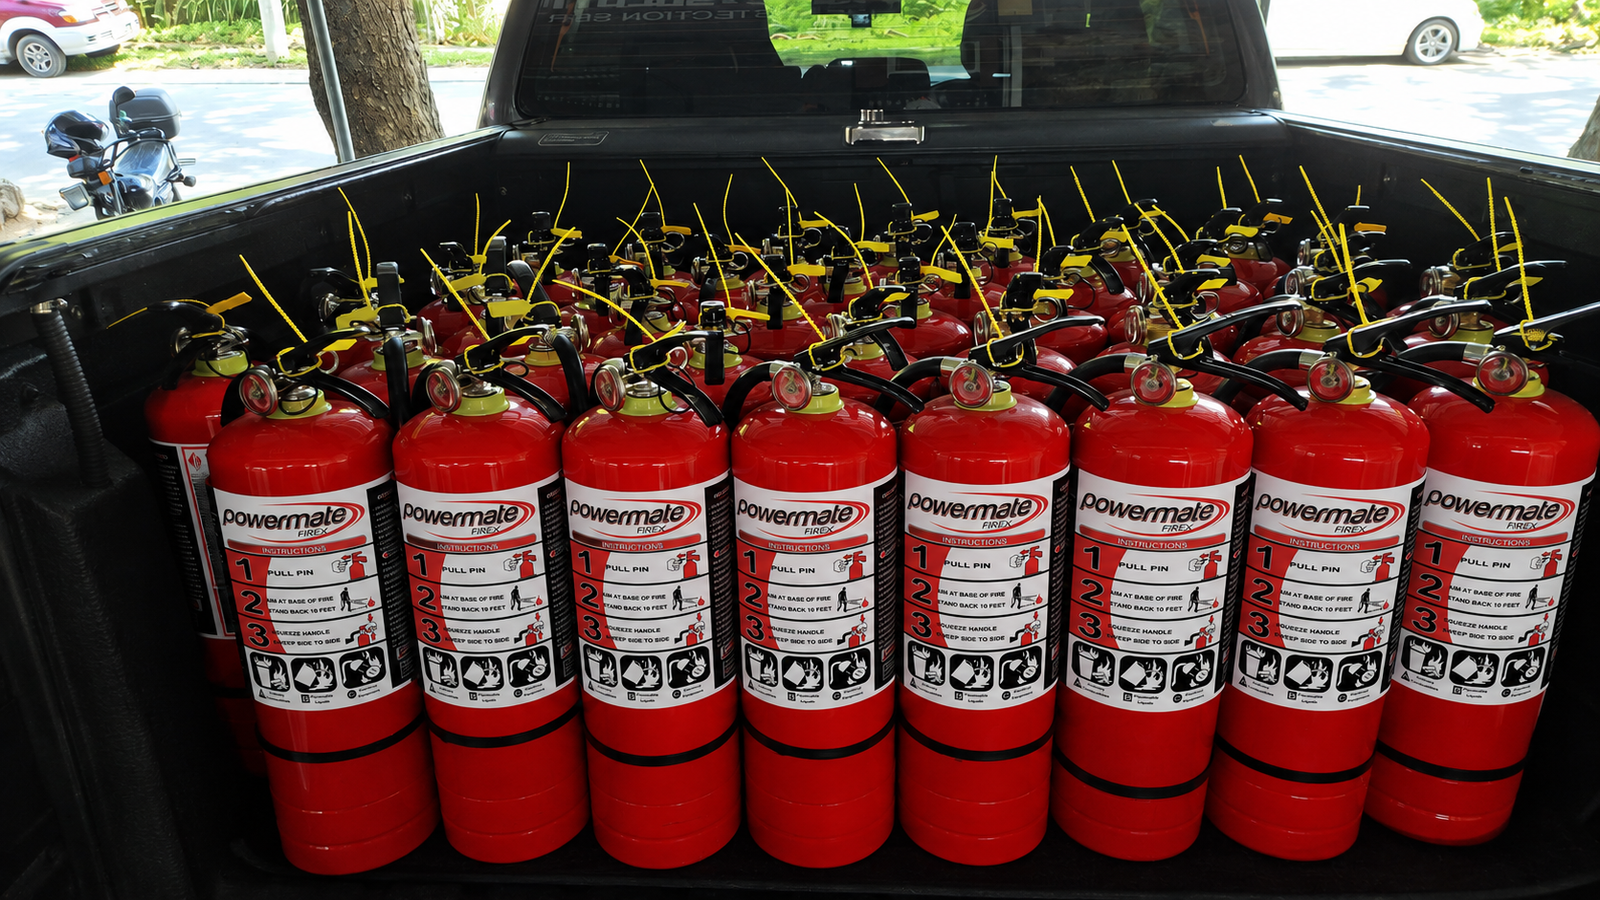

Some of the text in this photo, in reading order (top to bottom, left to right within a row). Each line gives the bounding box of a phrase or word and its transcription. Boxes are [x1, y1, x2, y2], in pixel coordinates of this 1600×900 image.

[402, 502, 520, 528] powermate
[569, 499, 685, 526] powermate
[736, 498, 854, 526] powermate
[907, 492, 1033, 520] powermate
[1079, 492, 1216, 524] powermate
[1255, 493, 1390, 524] powermate
[1424, 489, 1560, 522] powermate
[222, 506, 348, 530] powermate
[636, 525, 666, 534] FIREX
[981, 520, 1012, 530] FIREX
[1161, 523, 1194, 533] FIREX
[1334, 525, 1367, 534] FIREX
[1506, 522, 1538, 530] FIREX
[297, 527, 329, 537] FIREX
[471, 526, 501, 536] FIREX
[804, 526, 835, 536] FIREX
[942, 536, 1007, 546] INSTRUCTIONS
[1461, 534, 1531, 546] INSTRUCTIONS
[262, 546, 327, 555] INSTRUCTIONS
[436, 542, 498, 552] INSTRUCTIONS
[602, 541, 664, 550] INSTRUCTIONS
[768, 542, 830, 552] INSTRUCTIONS
[1117, 538, 1188, 549] INSTRUCTIONS
[1289, 538, 1360, 551] INSTRUCTIONS
[1425, 541, 1442, 565] 1
[412, 552, 428, 576] 1
[578, 550, 592, 574] 1
[605, 564, 630, 573] PULL
[743, 550, 756, 574] 1
[912, 544, 927, 570] 1
[943, 560, 971, 569] PULL
[1084, 546, 1100, 570] 1
[1118, 561, 1148, 572] PULL
[1256, 545, 1272, 570] 1
[1289, 561, 1318, 572] PULL
[1460, 556, 1511, 569] PULL PIN
[236, 558, 253, 581] 1
[442, 566, 467, 574] PULL
[770, 565, 796, 574] PULL
[416, 585, 437, 611] 2
[580, 582, 599, 609] 2
[744, 582, 763, 609] 2
[911, 577, 932, 606] 2
[1080, 578, 1104, 607] 2
[1250, 577, 1274, 606] 2
[1416, 573, 1443, 601] 2
[240, 590, 264, 615] 2
[489, 604, 506, 612] FEET
[1302, 604, 1324, 612] BACK
[1471, 600, 1492, 608] BACK
[421, 618, 442, 643] 3
[583, 615, 602, 641] 3
[746, 614, 764, 641] 3
[910, 611, 932, 638] 3
[1078, 612, 1102, 639] 3
[1247, 611, 1270, 638] 3
[1412, 606, 1437, 633] 3
[247, 622, 270, 648] 3
